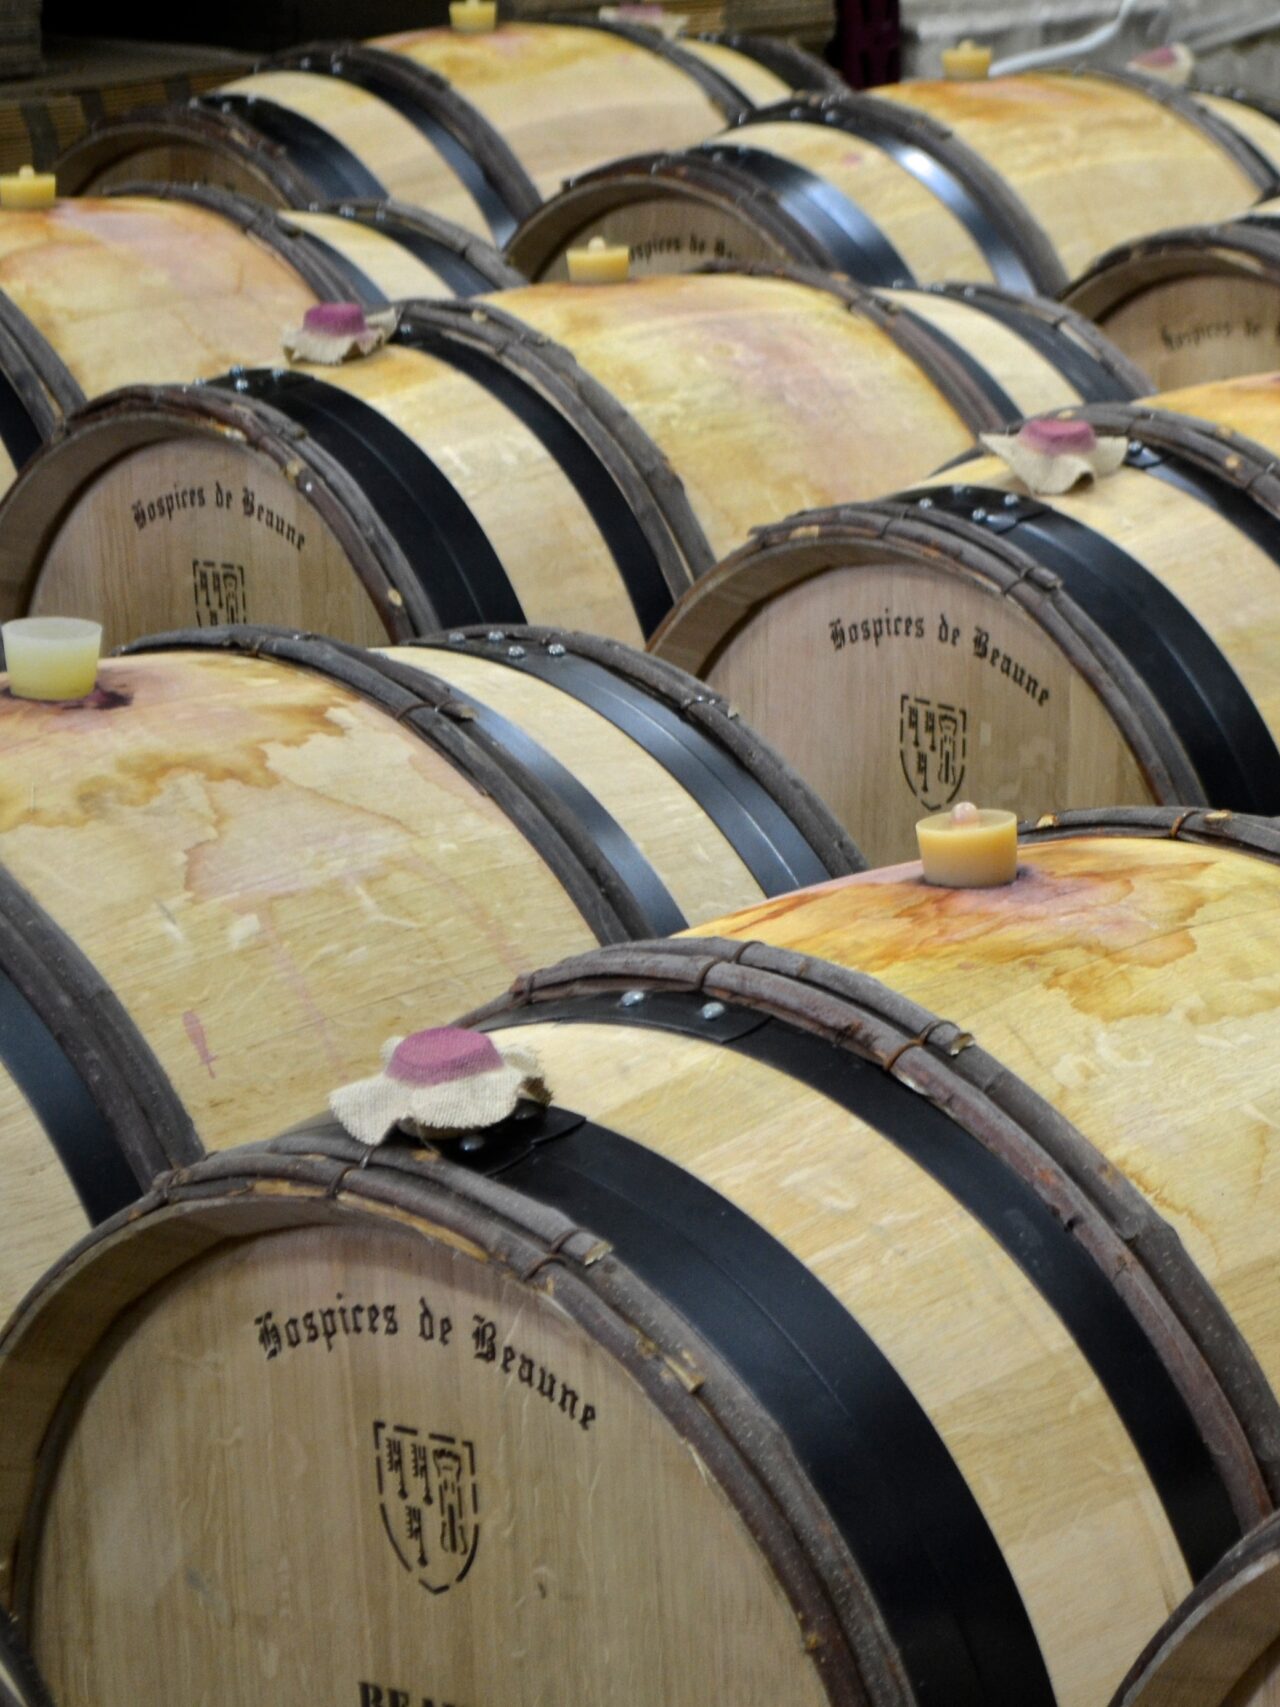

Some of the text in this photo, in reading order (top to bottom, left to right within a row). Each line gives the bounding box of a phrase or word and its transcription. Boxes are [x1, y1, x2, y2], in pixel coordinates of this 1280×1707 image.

[131, 480, 306, 551] Hospices de Beaune
[829, 608, 1050, 708] Hospices de Beaune
[254, 1292, 597, 1431] Hospices de Beaune
